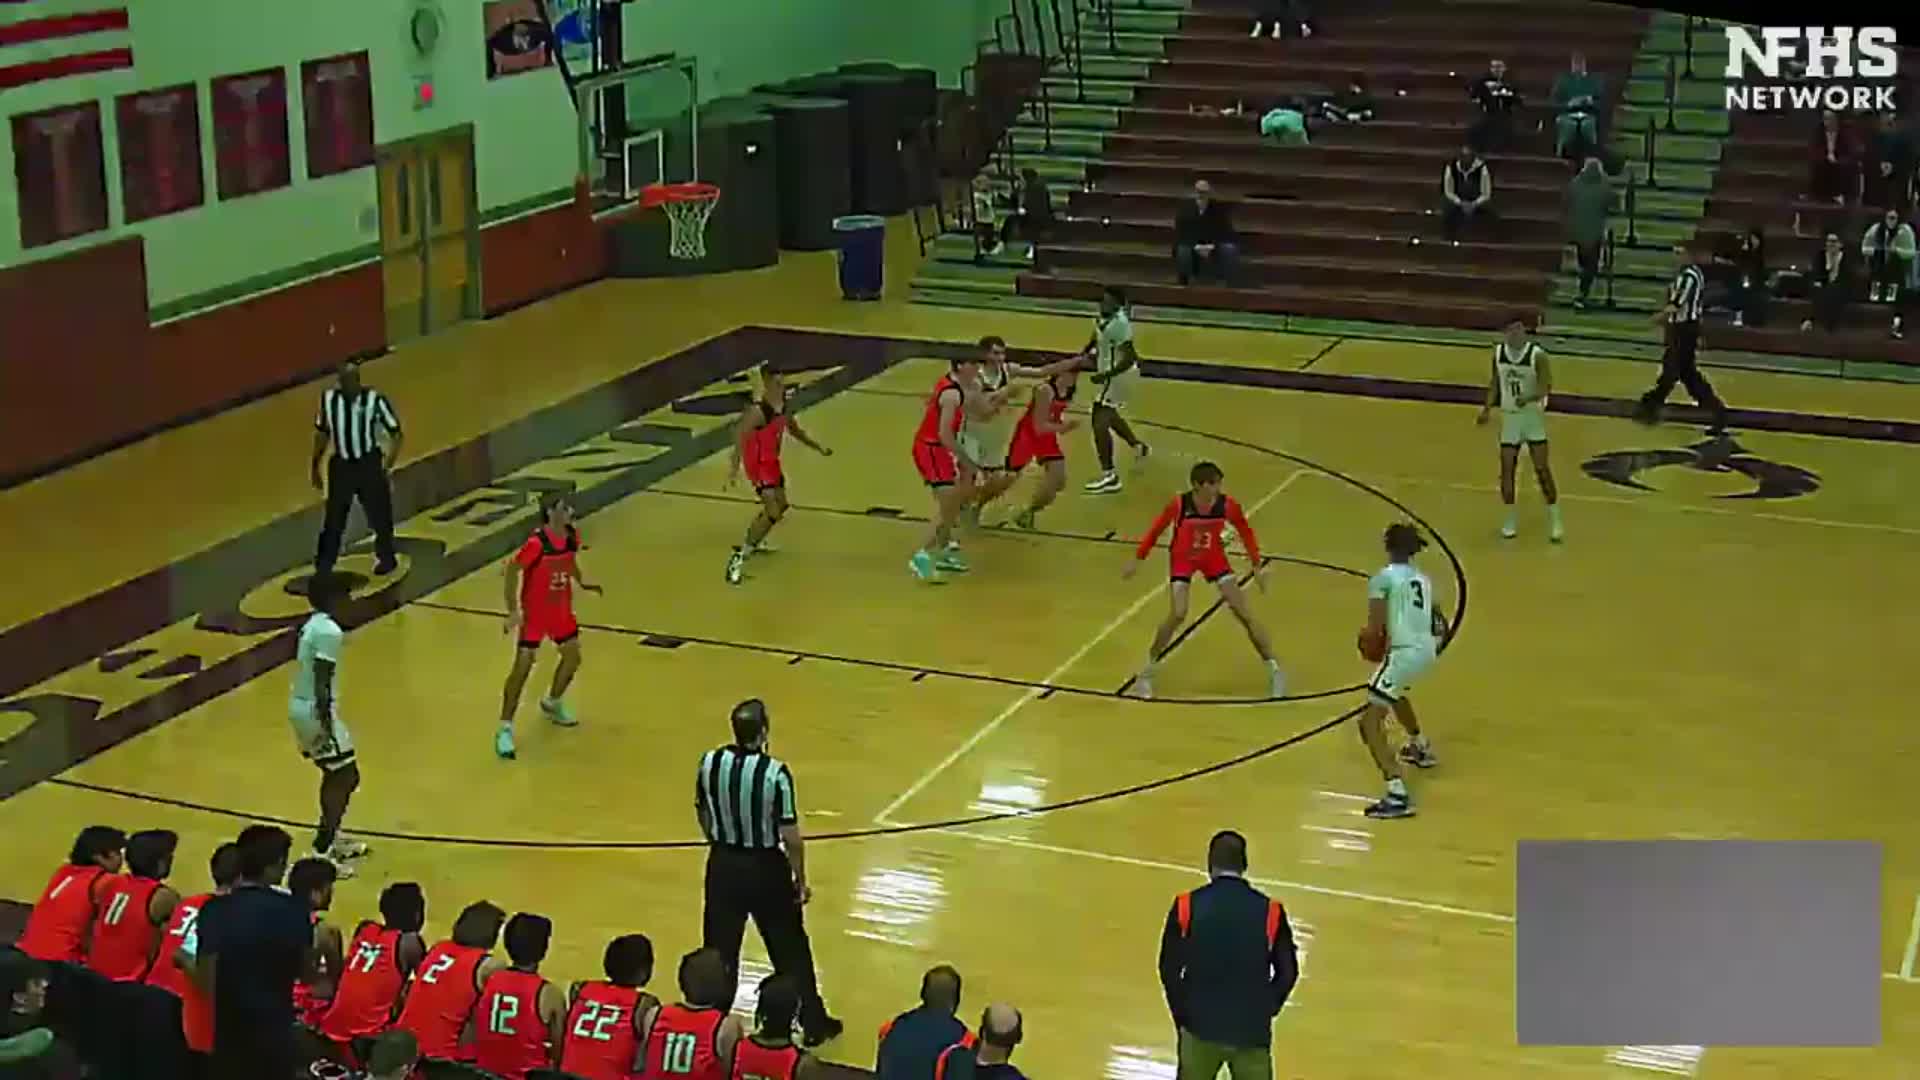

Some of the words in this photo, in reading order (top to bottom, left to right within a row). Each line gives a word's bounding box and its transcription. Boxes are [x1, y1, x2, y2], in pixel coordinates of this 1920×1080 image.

[1410, 580, 1425, 610] 3
[49, 874, 74, 899] 1
[104, 892, 131, 925] 11
[422, 953, 456, 984] 2
[490, 992, 519, 1035] 12
[573, 999, 621, 1041] 22
[662, 1032, 697, 1074] 10
